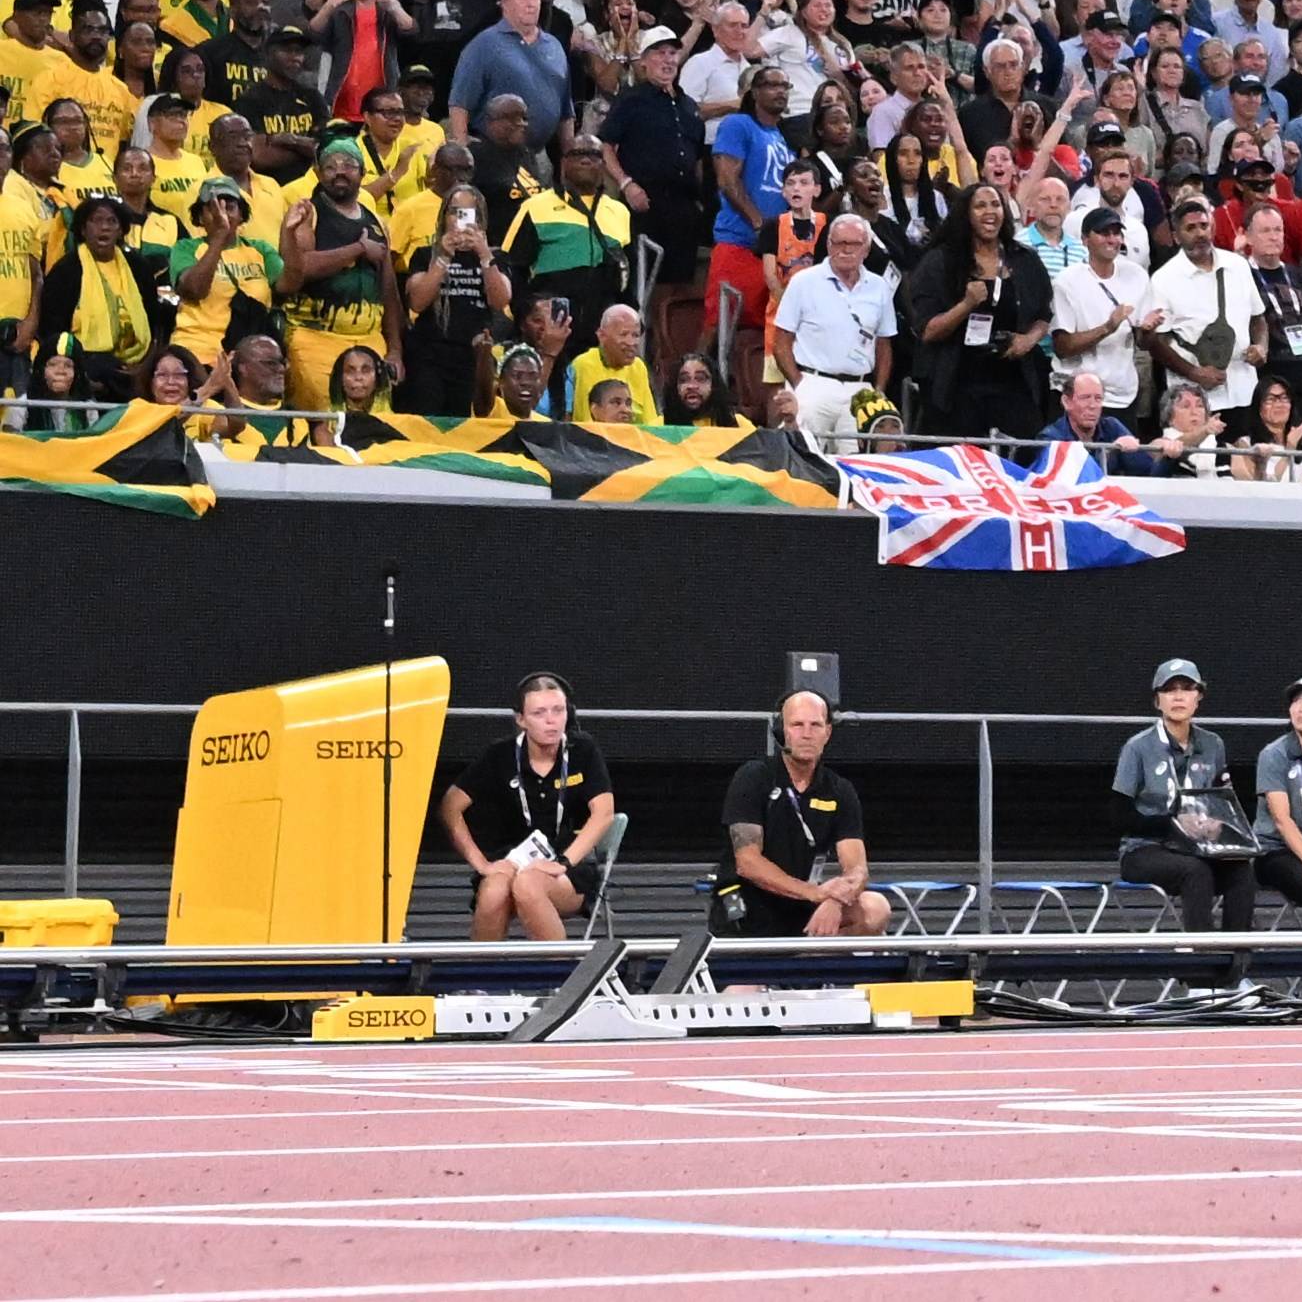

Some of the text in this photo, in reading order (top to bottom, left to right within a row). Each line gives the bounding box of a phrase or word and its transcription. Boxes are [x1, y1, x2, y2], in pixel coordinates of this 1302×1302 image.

[200, 729, 271, 767] SEIKO
[316, 739, 404, 760] SEIKO
[348, 1009, 427, 1028] SEIKO
